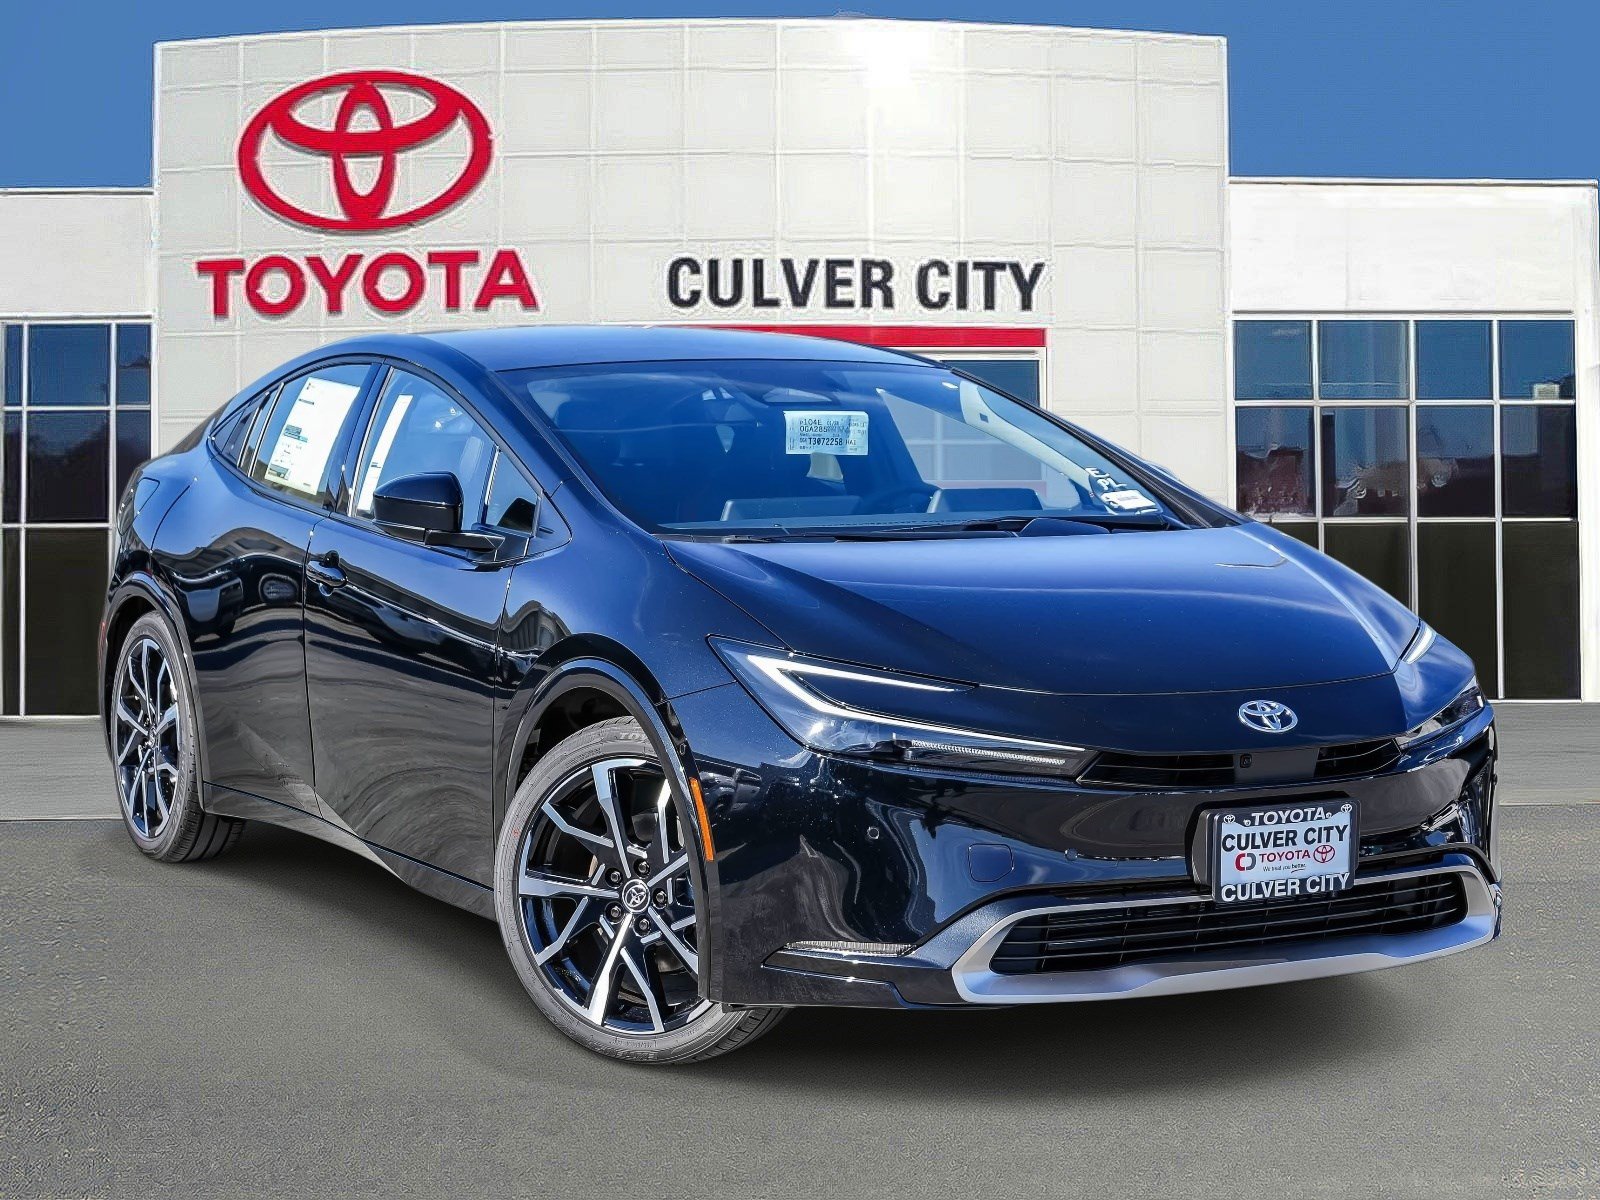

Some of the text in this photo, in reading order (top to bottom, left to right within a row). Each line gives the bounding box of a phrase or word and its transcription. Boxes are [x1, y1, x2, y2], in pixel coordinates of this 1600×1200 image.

[197, 249, 540, 318] TOYOTA
[667, 257, 1046, 312] CULVER CITY
[1251, 807, 1326, 826] TOYOTA
[1222, 824, 1349, 852] CULVER CITY
[1259, 849, 1311, 863] TOYOTA
[1221, 872, 1350, 902] CULVER CITY
